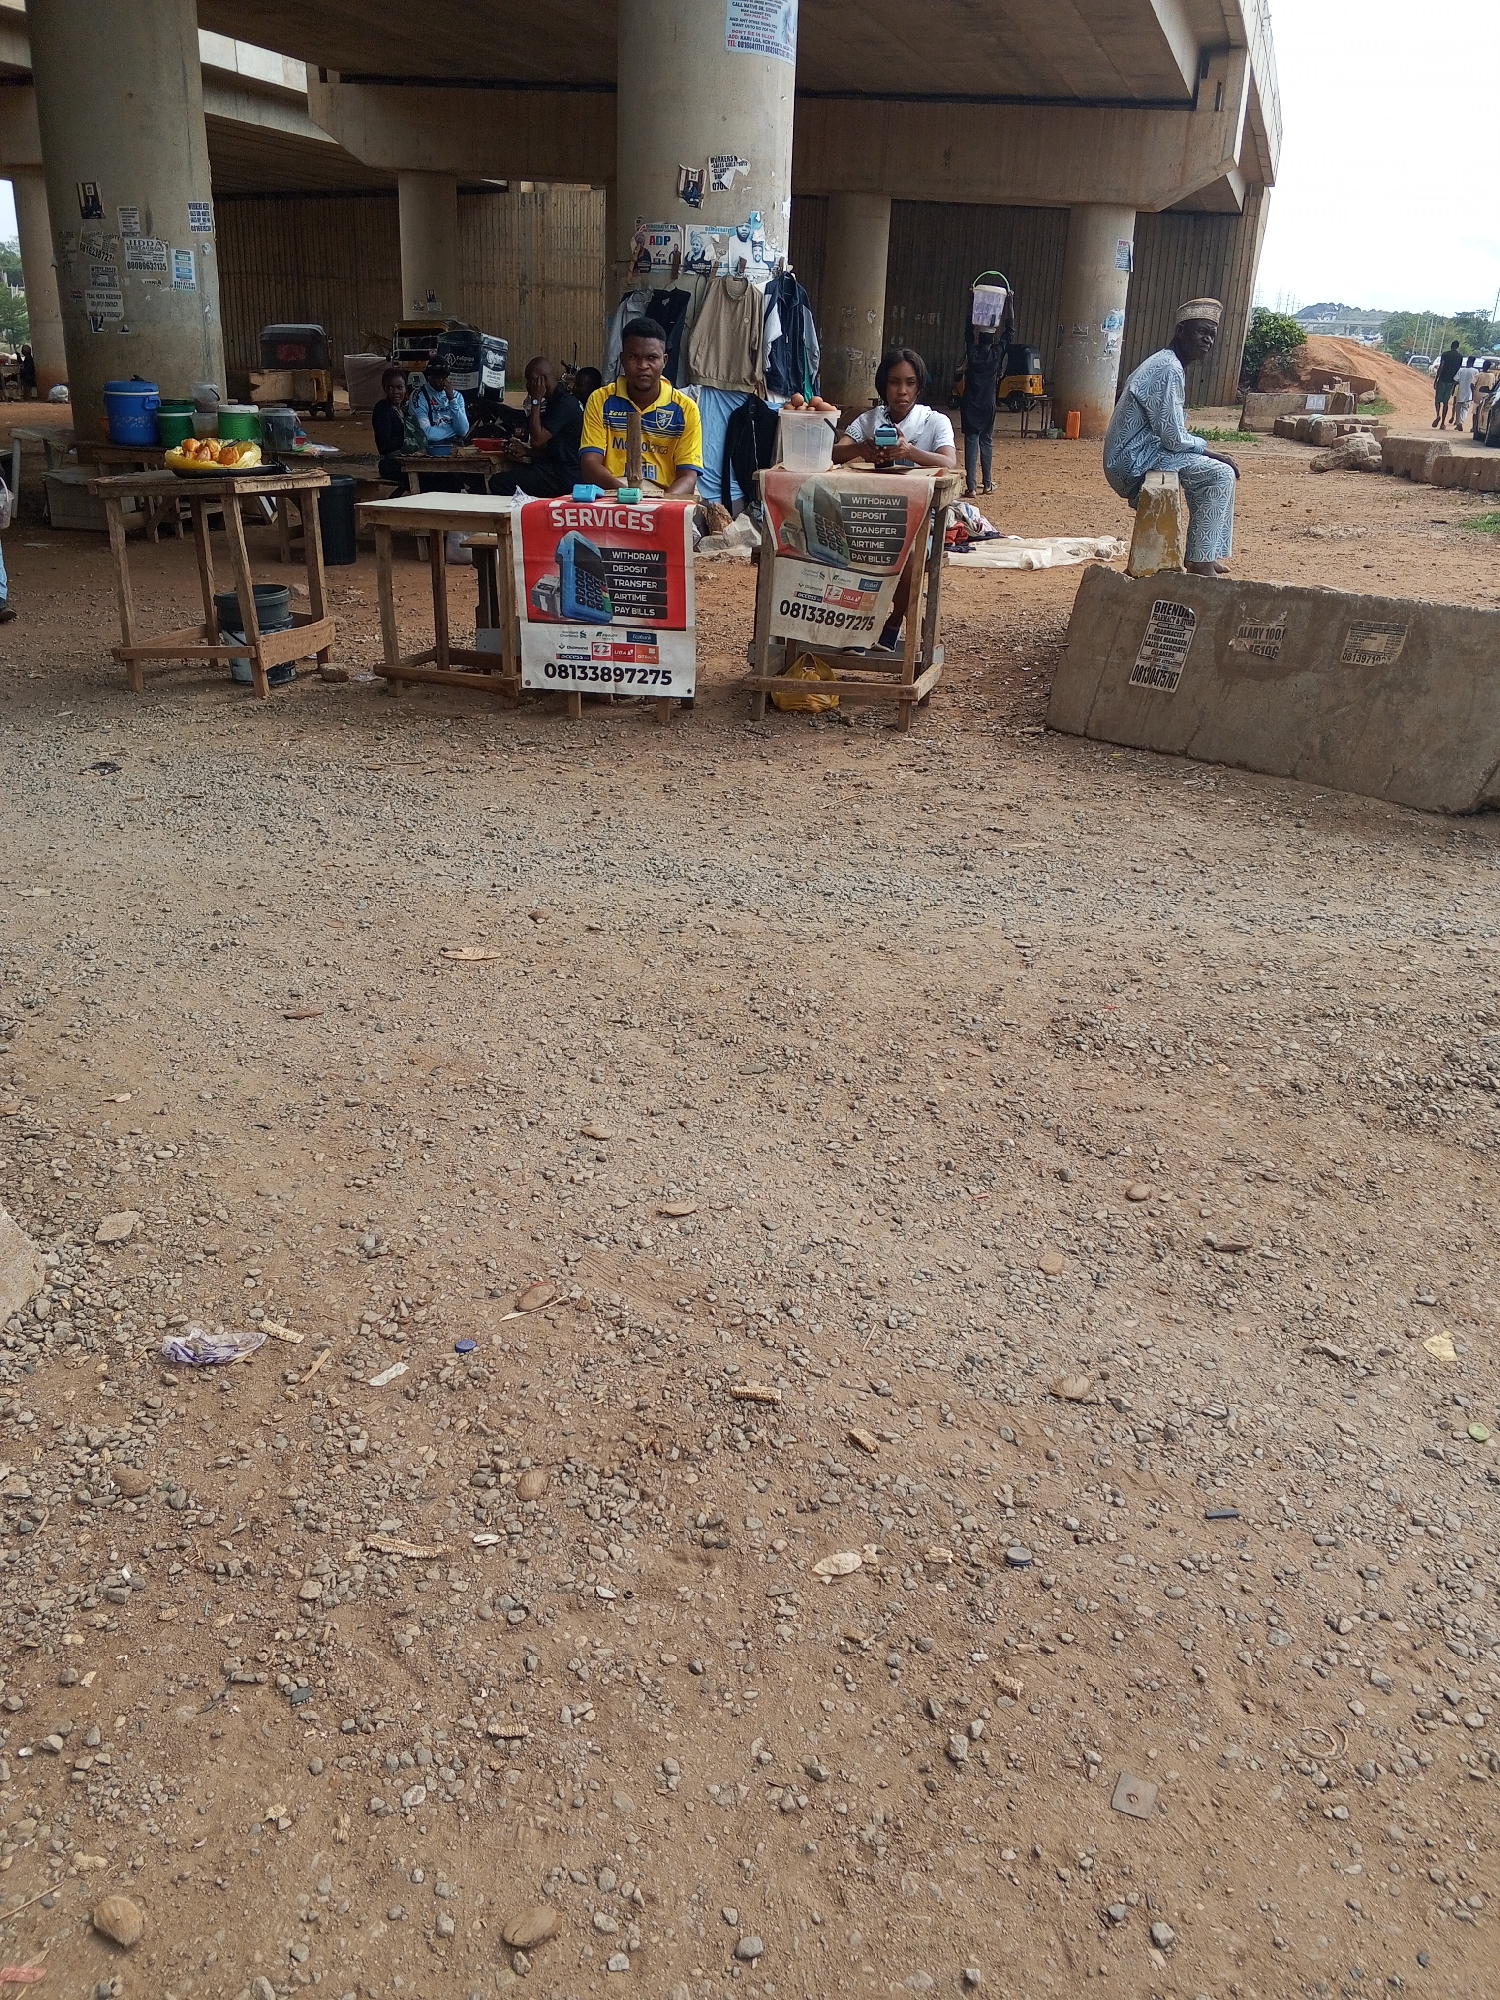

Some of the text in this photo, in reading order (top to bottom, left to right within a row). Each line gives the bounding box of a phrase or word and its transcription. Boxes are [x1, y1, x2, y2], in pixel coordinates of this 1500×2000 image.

[649, 235, 671, 246] ADP
[851, 497, 901, 506] WITHDRAW
[551, 508, 654, 532] SERVICES
[851, 512, 887, 520] DEPOSIT
[851, 526, 897, 535] TRANSFER
[851, 540, 885, 549] AIRTIME
[612, 551, 660, 561] WITHDRAW
[852, 552, 892, 564] PAY BILLS
[612, 564, 648, 574] DEPOSIT
[613, 578, 658, 589] TRANSFER
[614, 592, 647, 602] AIRTIME
[614, 606, 655, 616] PAY BILLS
[780, 600, 875, 631] 08133897275
[1154, 628, 1186, 638] PHARMACIST
[1163, 637, 1188, 646] MANAGER
[1159, 643, 1186, 653] ASSOCIATE
[1151, 649, 1175, 658] CLEANERS
[544, 663, 672, 685] 08133897275
